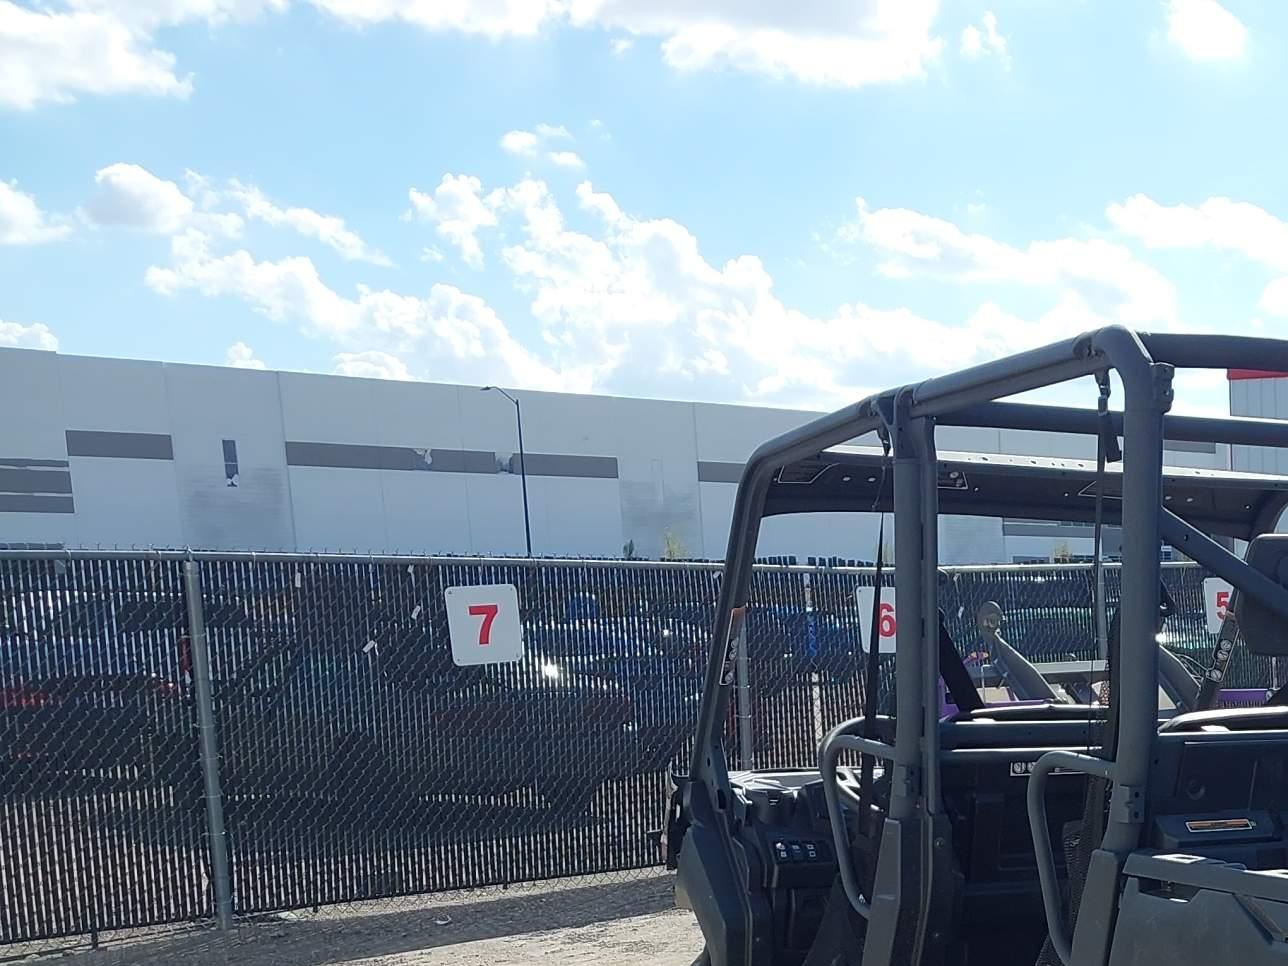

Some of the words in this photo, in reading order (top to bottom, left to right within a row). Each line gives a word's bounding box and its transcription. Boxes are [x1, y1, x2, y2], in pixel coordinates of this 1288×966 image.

[879, 603, 897, 637] 6
[1217, 592, 1230, 620] 5
[468, 604, 498, 645] 7
